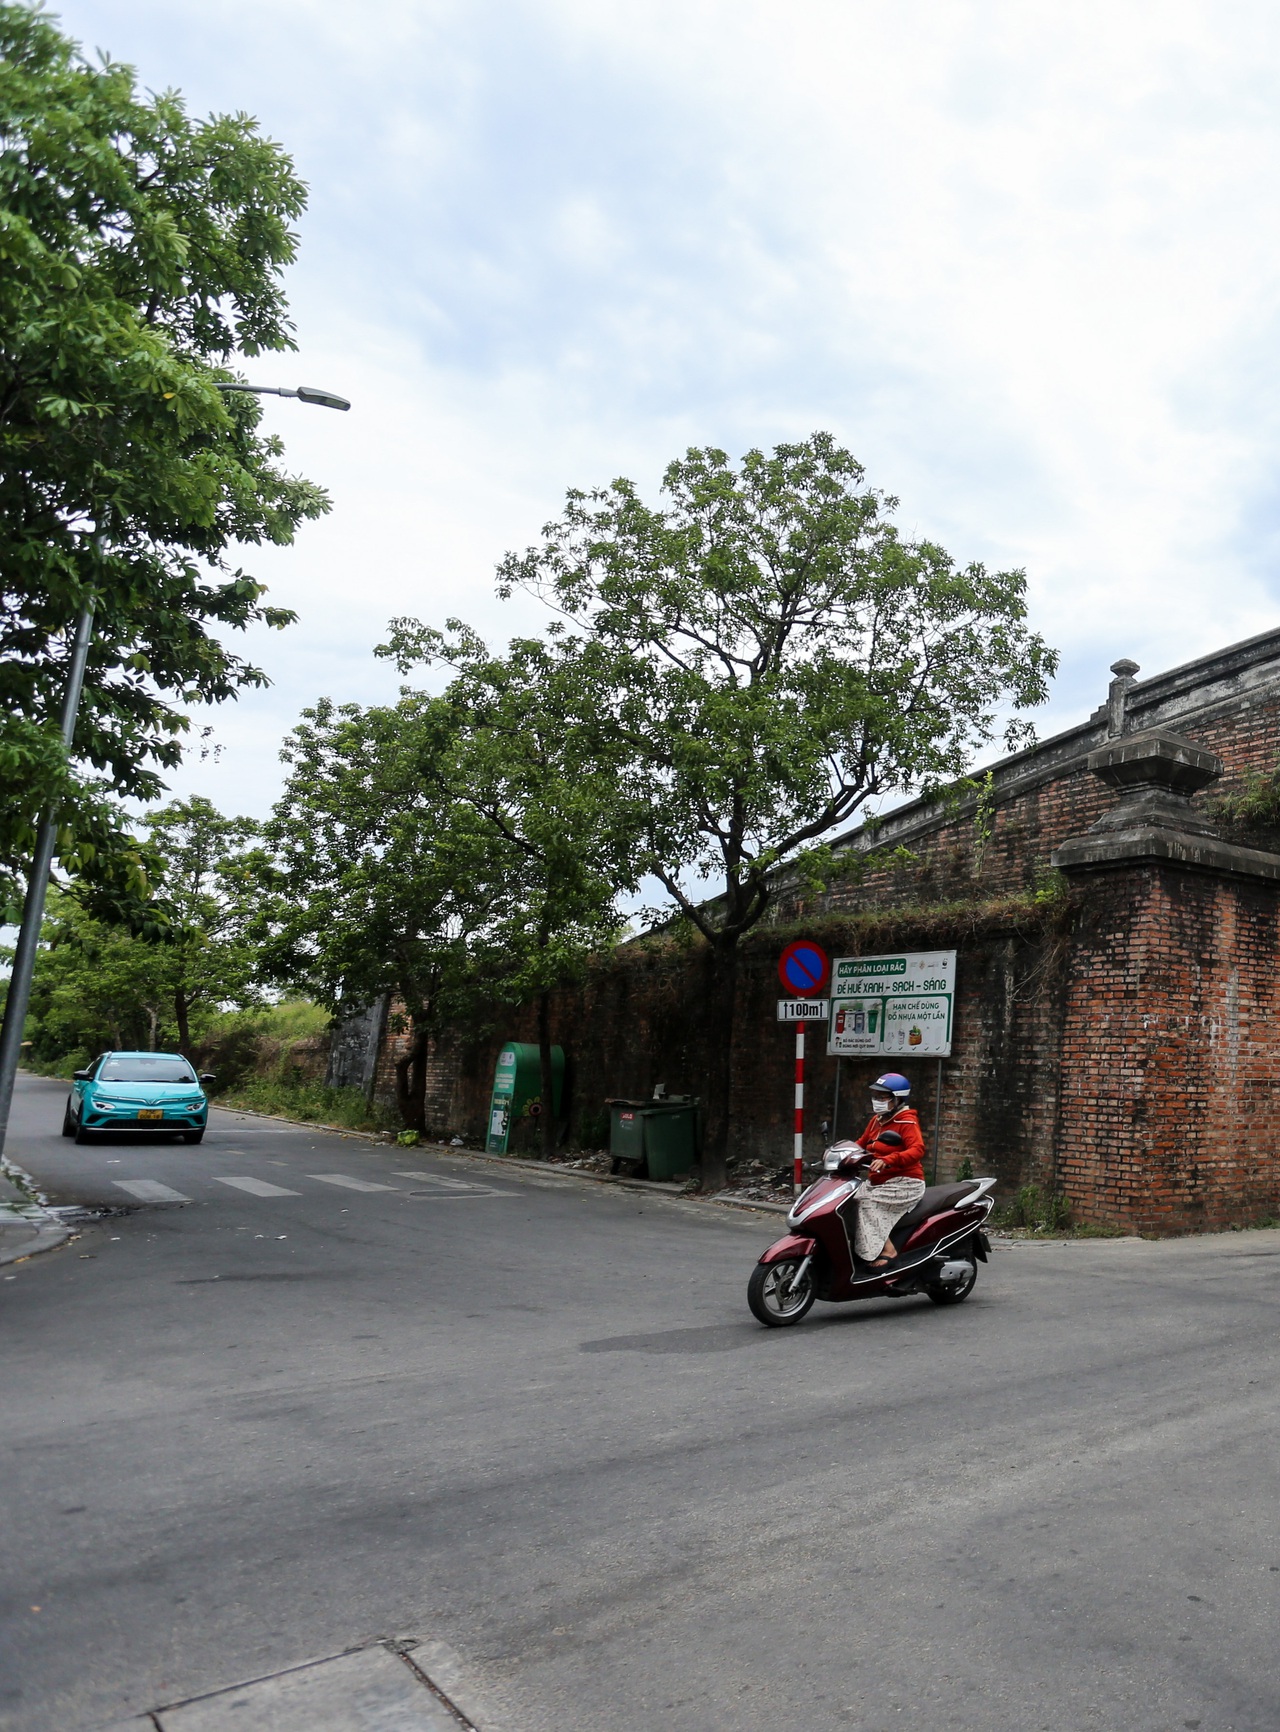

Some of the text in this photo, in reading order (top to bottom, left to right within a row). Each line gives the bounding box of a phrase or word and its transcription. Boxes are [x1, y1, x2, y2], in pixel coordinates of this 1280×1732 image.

[839, 965, 852, 974] HÃY
[853, 963, 872, 973] PHÂN
[873, 963, 889, 975] LOẠI
[890, 962, 905, 971] RÁC
[837, 979, 846, 994] ĐỂ
[848, 979, 863, 993] HUẾ
[863, 982, 884, 993] XANH
[892, 981, 915, 994] SẠCH
[923, 977, 947, 990] SÁNG
[789, 1003, 819, 1016] 100m
[892, 1000, 940, 1011] HẠN CHẾ DÙNG
[898, 1012, 916, 1021] NHỰA
[917, 1011, 932, 1020] MỘT
